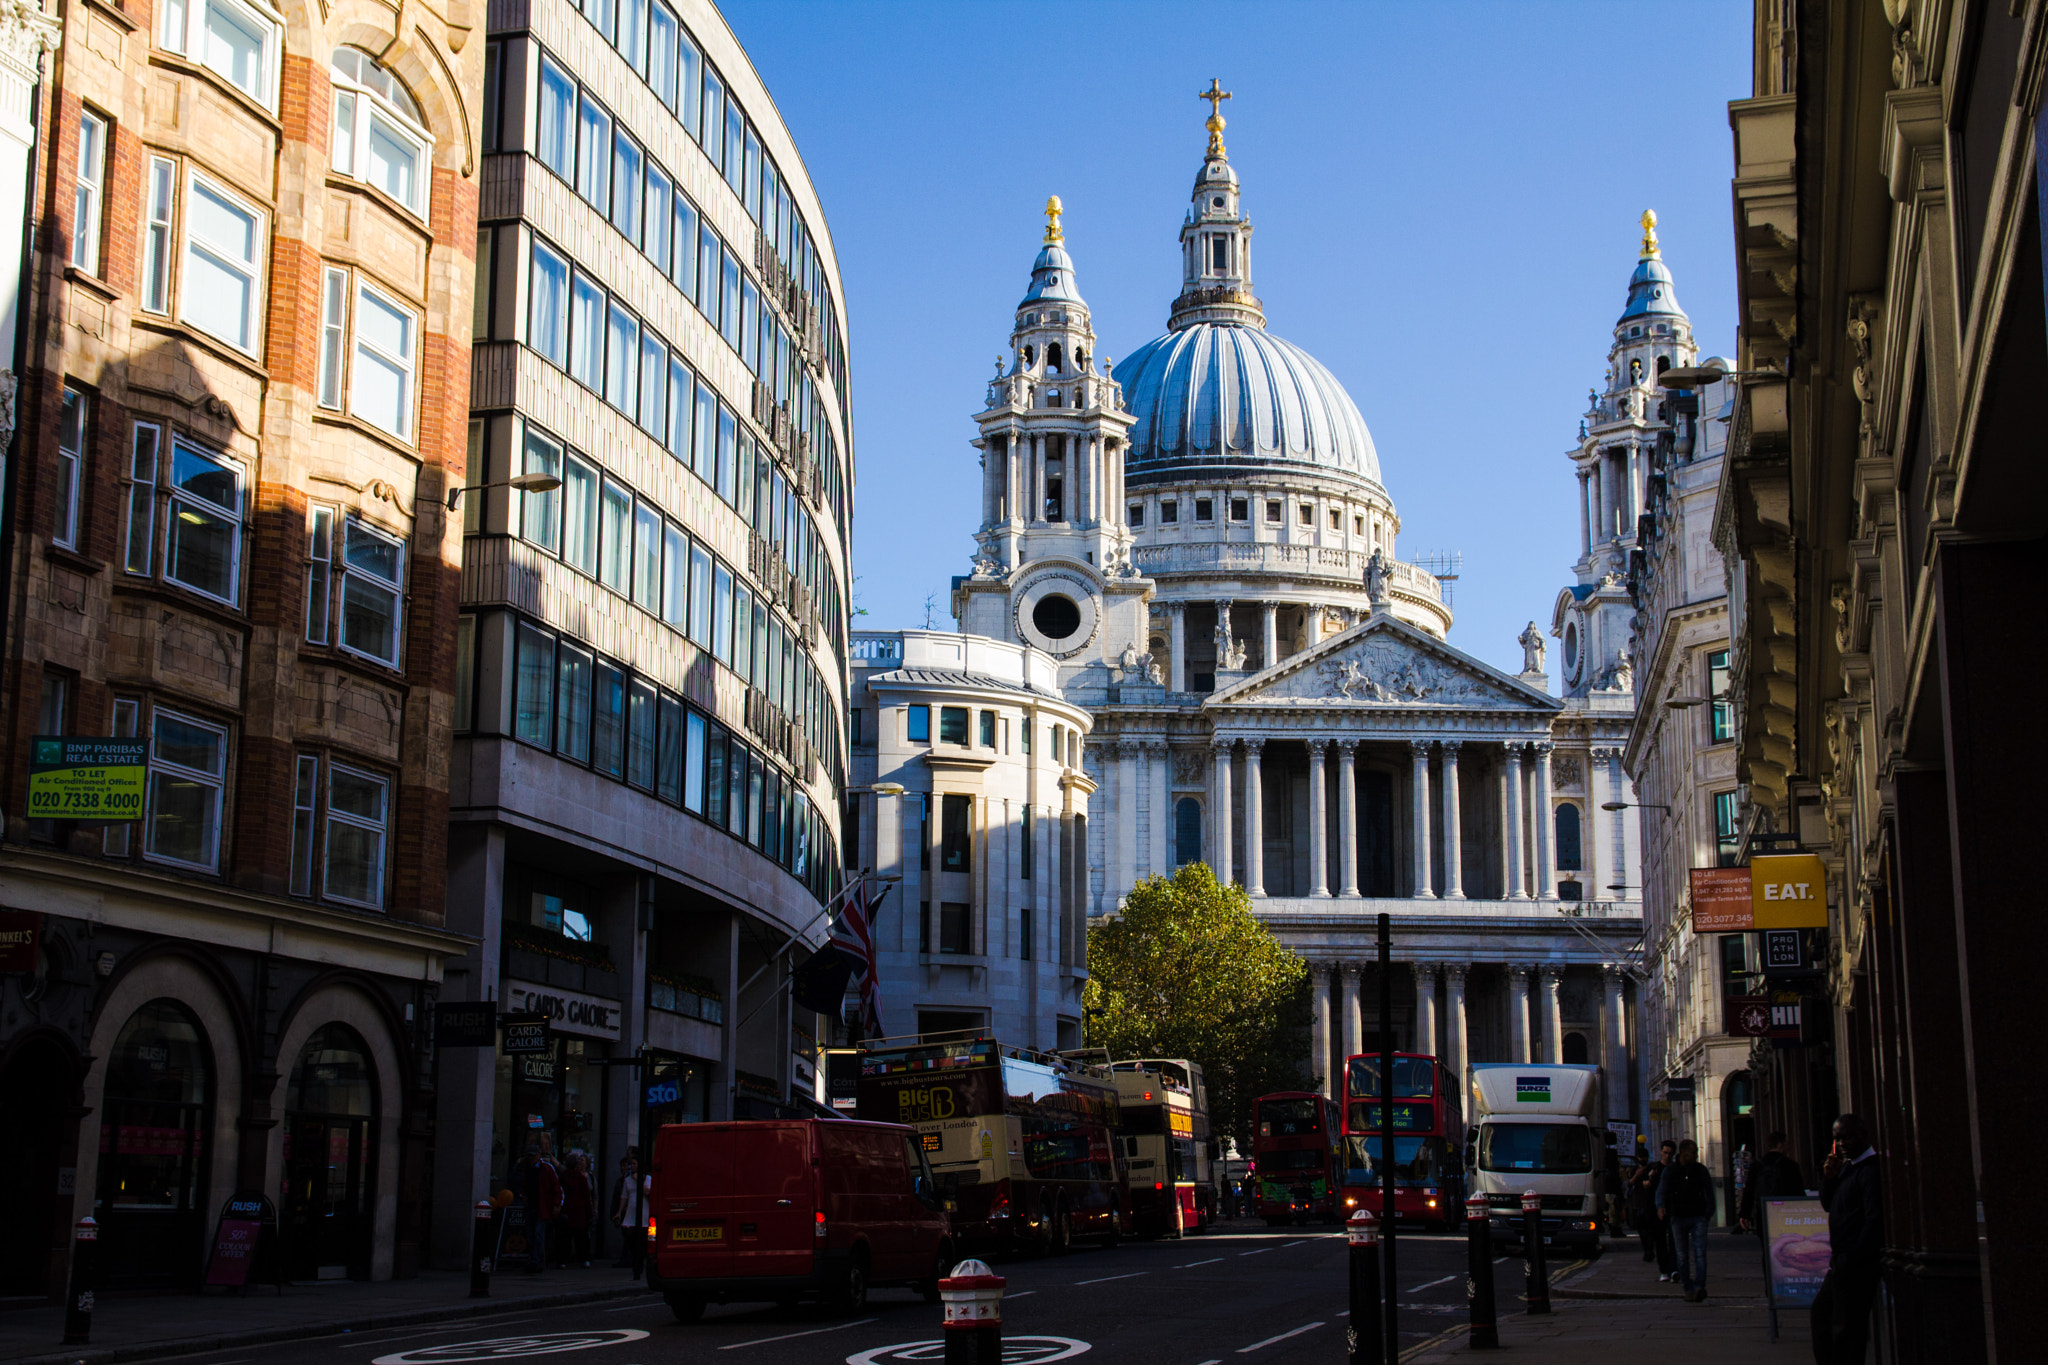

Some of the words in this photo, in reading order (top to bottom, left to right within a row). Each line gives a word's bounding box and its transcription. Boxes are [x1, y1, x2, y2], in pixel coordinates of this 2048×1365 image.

[66, 744, 92, 753] BNP
[94, 744, 144, 754] PARIBAS
[66, 754, 96, 763] REAL
[98, 755, 140, 764] ESTATE
[89, 770, 106, 778] LET
[53, 777, 106, 785] Conditioned
[108, 778, 137, 786] Offices
[32, 792, 60, 807] 020
[63, 792, 99, 808] 7338
[104, 793, 140, 809] 4000
[1764, 883, 1815, 901] EAT.
[1696, 915, 1712, 924] 020
[1714, 914, 1735, 923] 3077
[1736, 913, 1754, 922] 345
[1774, 953, 1795, 961] LON
[525, 992, 565, 1021] CARDS
[568, 1001, 609, 1029] GALORE
[441, 1011, 488, 1029] RUSH
[508, 1025, 543, 1037] CARDS
[506, 1036, 547, 1048] GALORE
[525, 1060, 554, 1078] GALORE
[880, 1073, 966, 1087] www.bigbustours.com
[898, 1089, 929, 1106] BIG
[900, 1105, 931, 1123] BUS
[1402, 1108, 1410, 1117] 4
[943, 1120, 978, 1130] London
[1282, 1122, 1296, 1133] 76
[1376, 1119, 1408, 1127] Wrloo
[231, 1201, 262, 1212] RUSH
[676, 1228, 700, 1239] MV62
[701, 1228, 718, 1238] OAE
